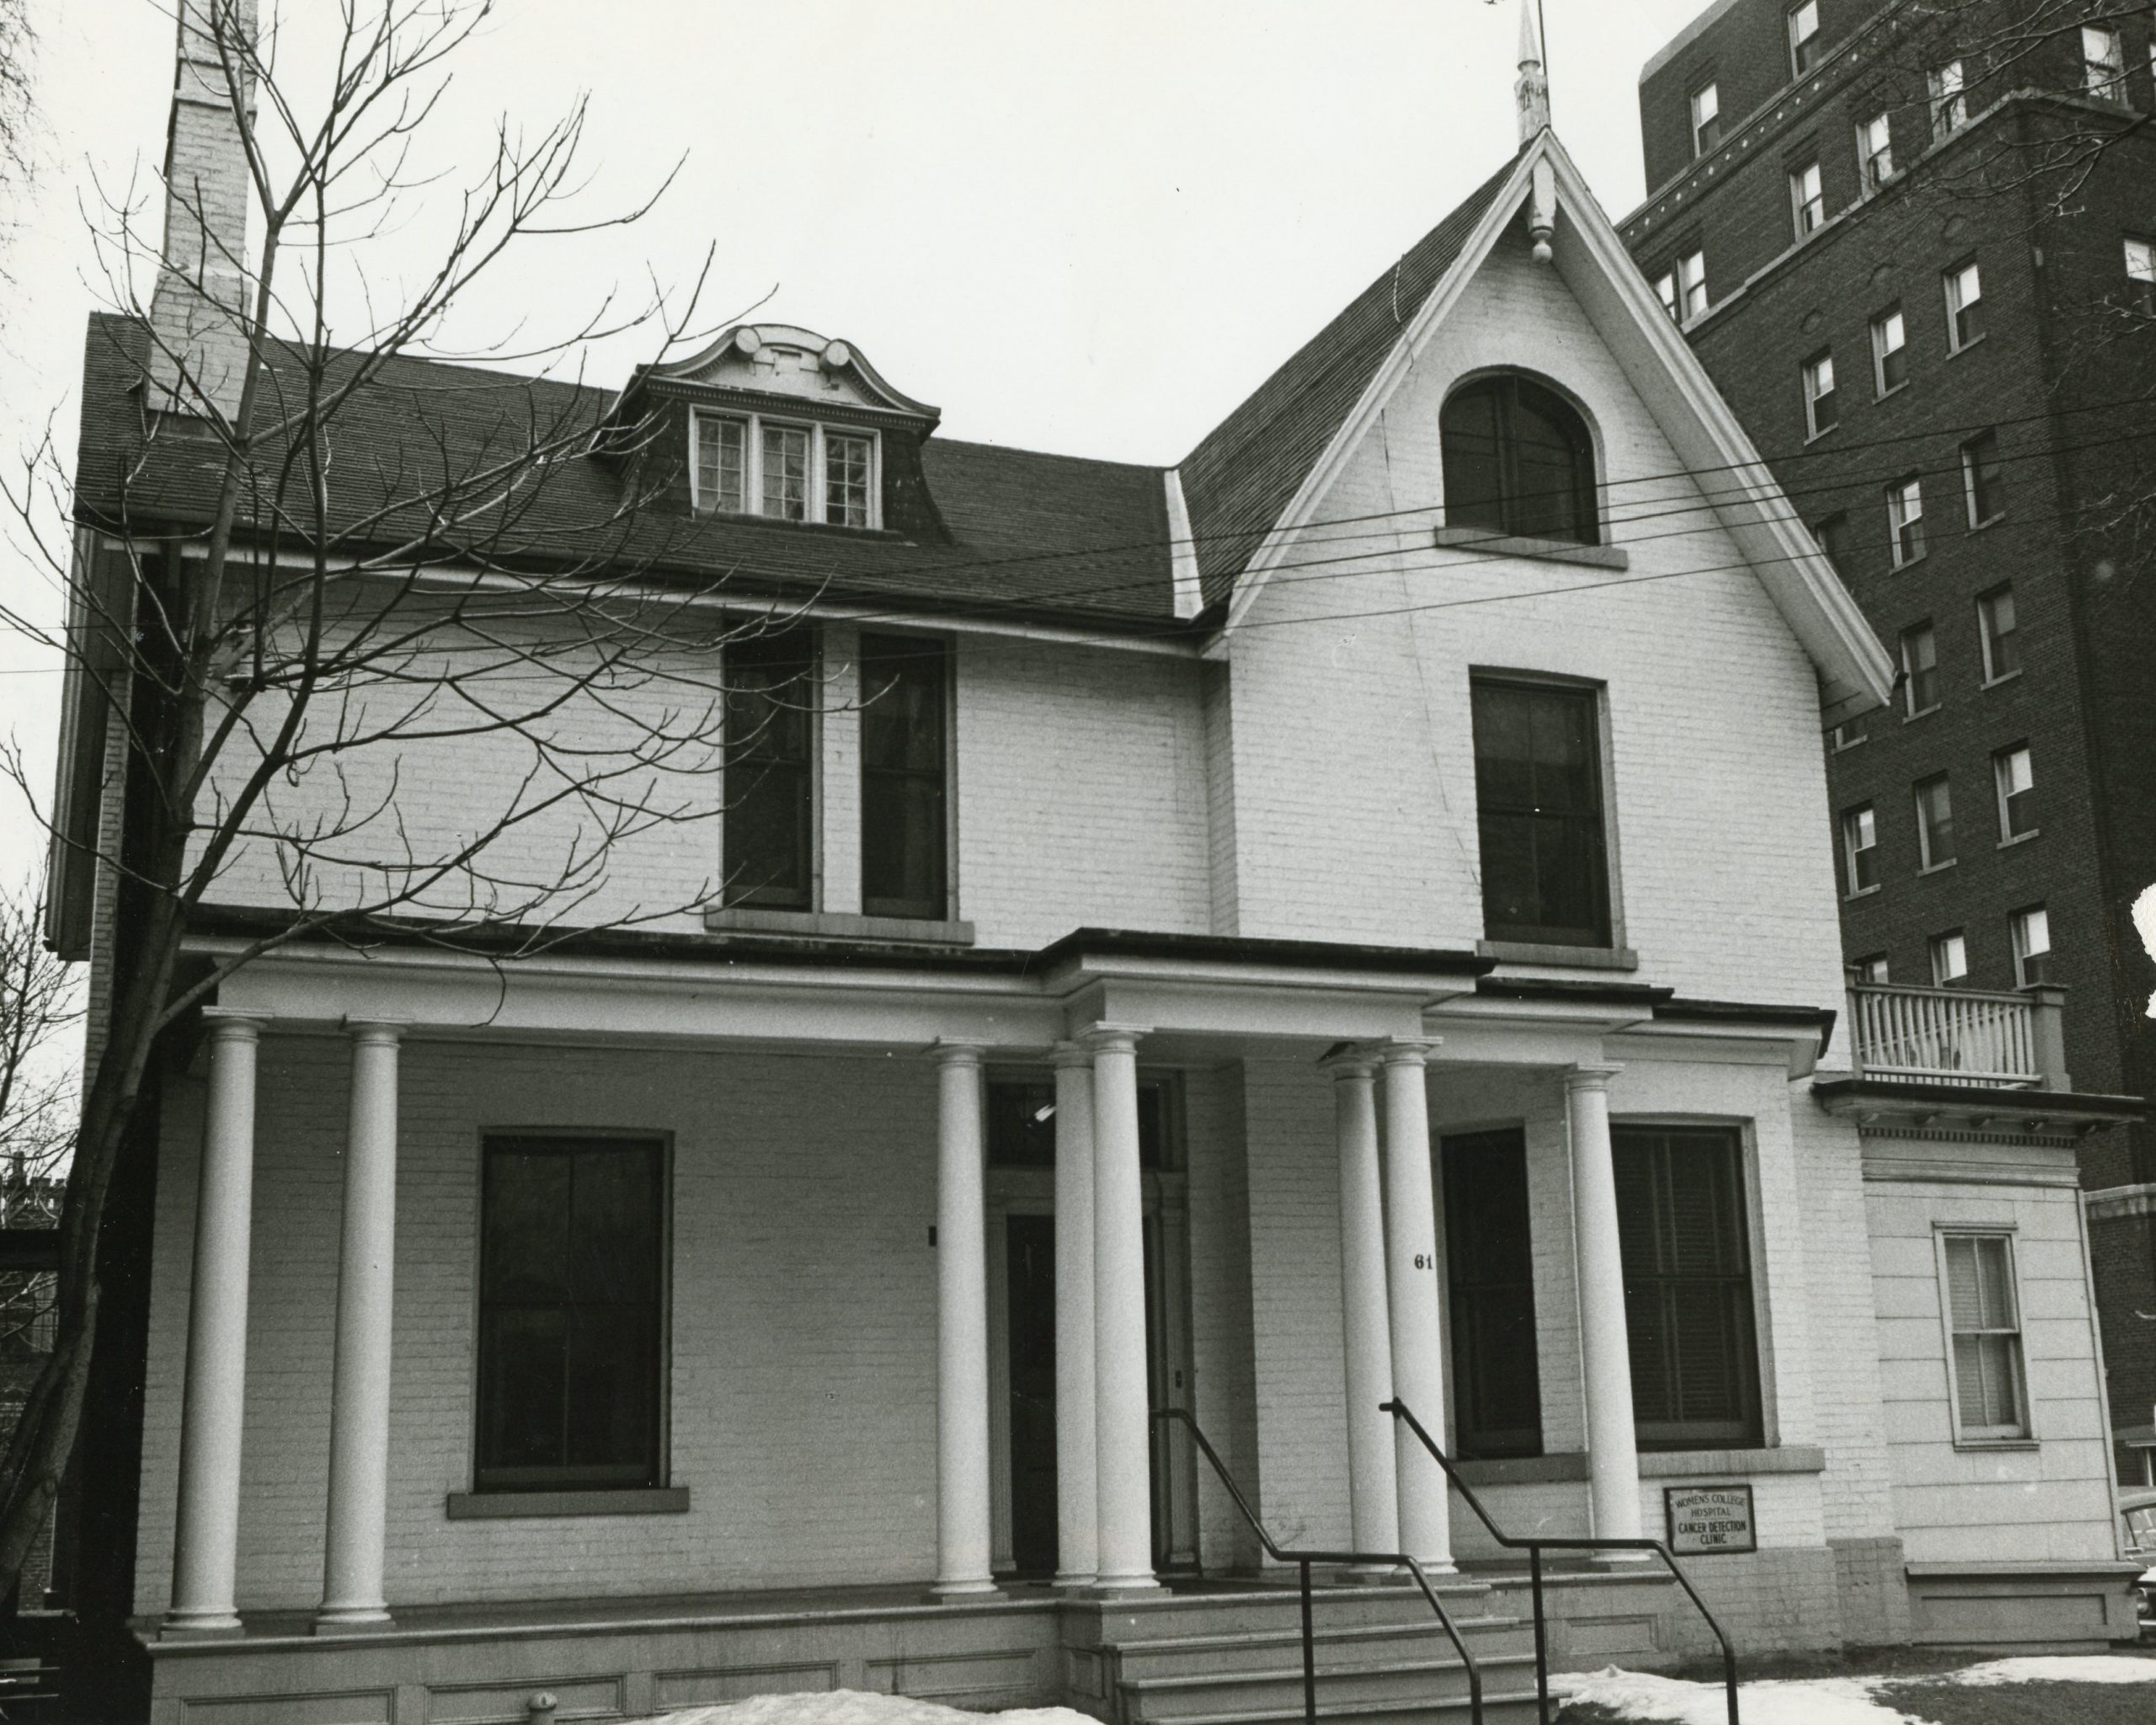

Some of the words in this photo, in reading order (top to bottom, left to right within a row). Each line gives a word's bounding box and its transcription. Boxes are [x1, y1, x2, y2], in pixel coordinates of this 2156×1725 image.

[1414, 1253, 1433, 1270] 61
[1711, 1494, 1746, 1506] COLLEGE
[1691, 1507, 1732, 1517] HOSPITAL
[1678, 1523, 1706, 1533] CANCER
[1709, 1520, 1746, 1532] DETECTION
[1700, 1534, 1726, 1545] CLINIC
